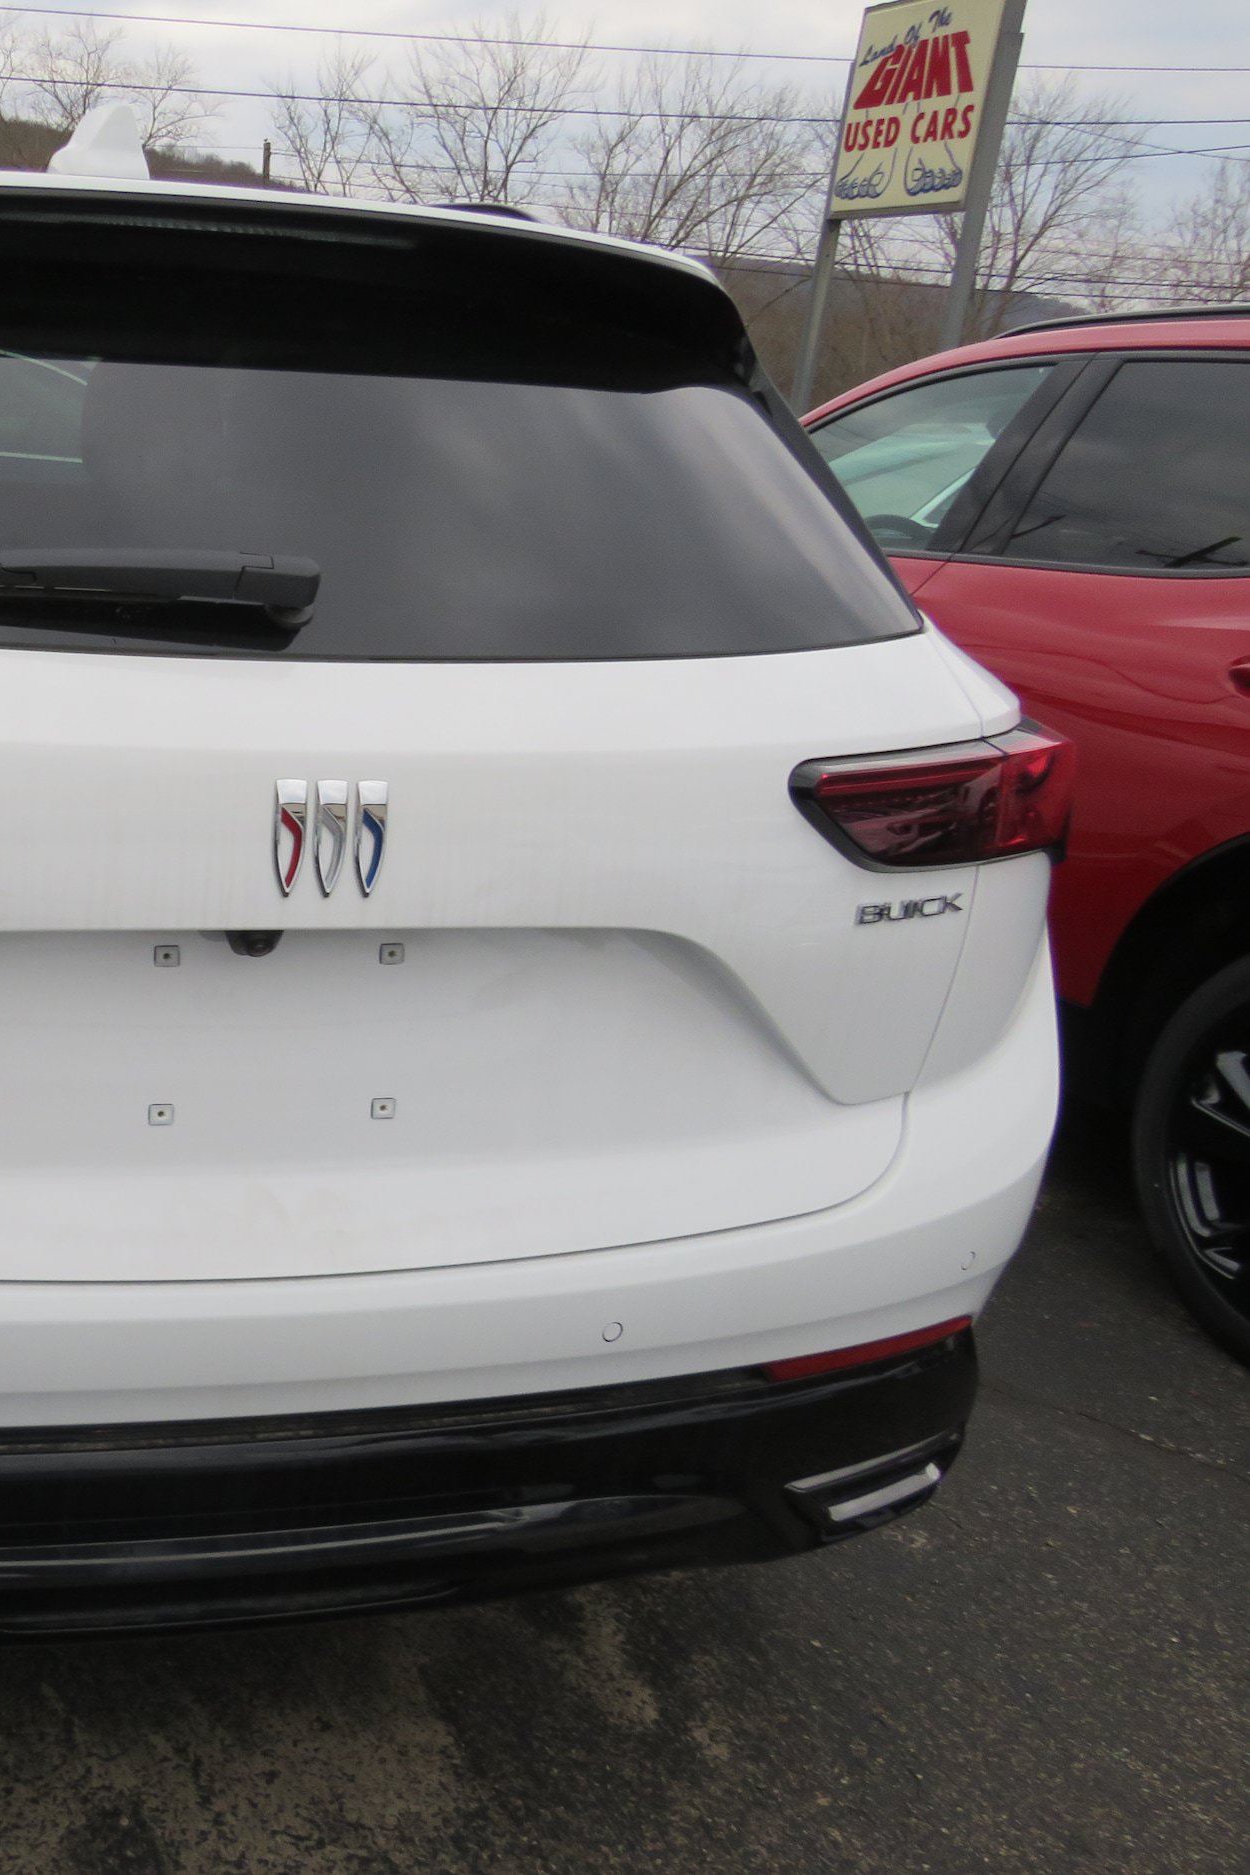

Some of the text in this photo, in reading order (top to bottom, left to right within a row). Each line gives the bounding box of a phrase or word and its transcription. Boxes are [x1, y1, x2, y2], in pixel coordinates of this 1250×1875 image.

[853, 30, 973, 110] GIANT
[844, 104, 975, 152] USED CARS
[854, 892, 963, 925] BUICK
